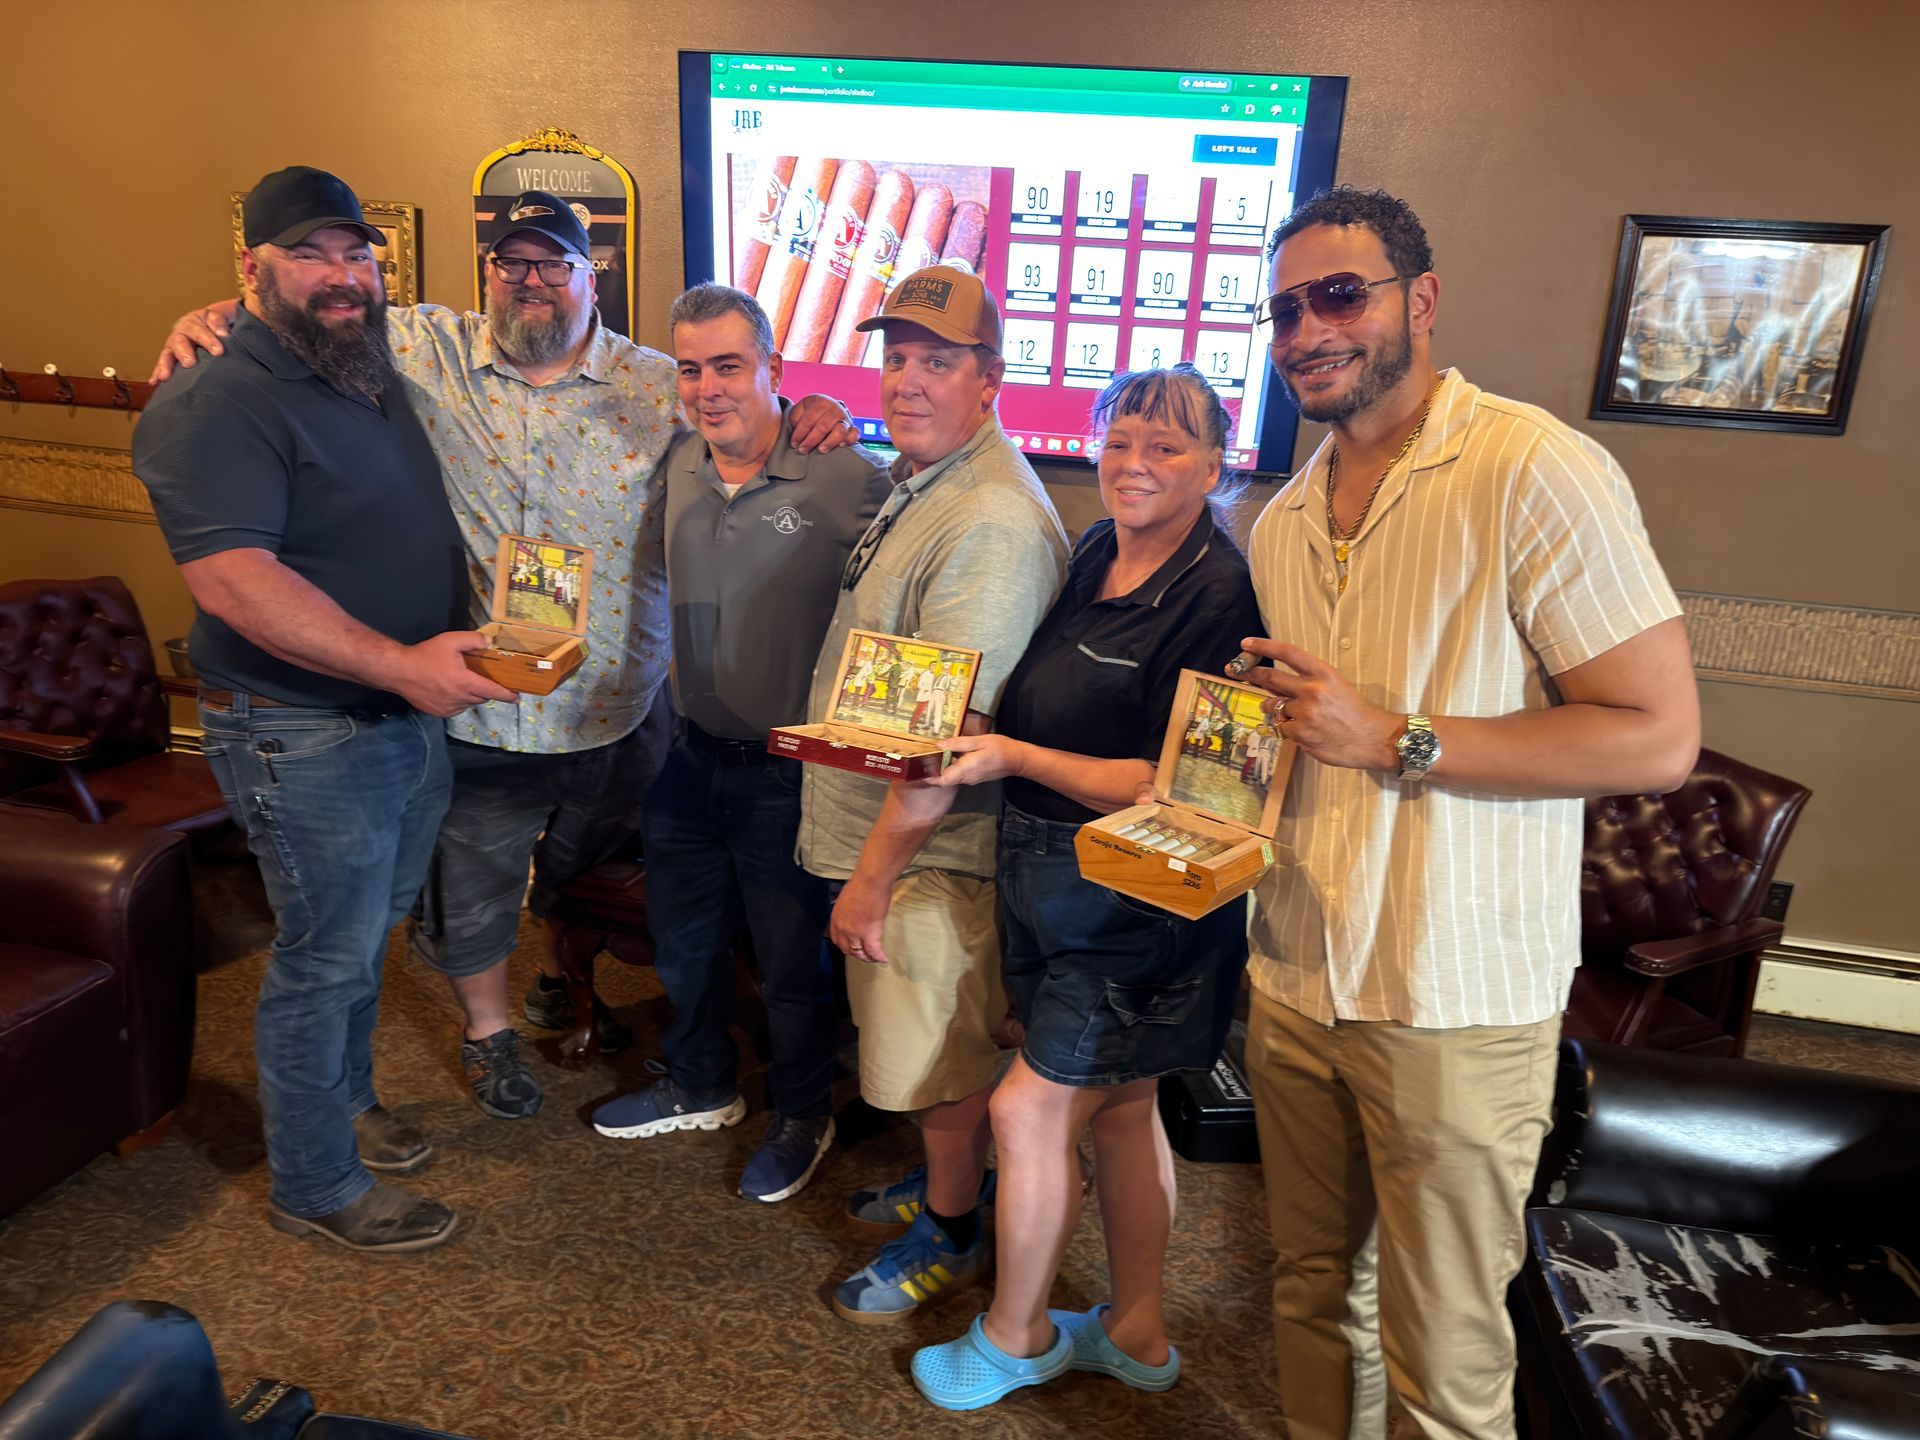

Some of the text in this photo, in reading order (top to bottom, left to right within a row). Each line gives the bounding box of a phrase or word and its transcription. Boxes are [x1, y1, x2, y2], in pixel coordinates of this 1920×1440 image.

[732, 109, 762, 128] JRE
[1211, 145, 1258, 154] LET'S TALK
[516, 168, 592, 192] WELCOME
[1027, 186, 1049, 210] 90
[1236, 197, 1246, 221] 5
[589, 259, 609, 270] OX
[1024, 264, 1041, 287] 93
[1086, 268, 1106, 291] 91
[1152, 271, 1175, 295] 90
[1219, 275, 1239, 299] 91
[1019, 339, 1036, 361] 12
[1082, 343, 1099, 365] 12
[1212, 351, 1229, 374] 13
[777, 514, 796, 530] A
